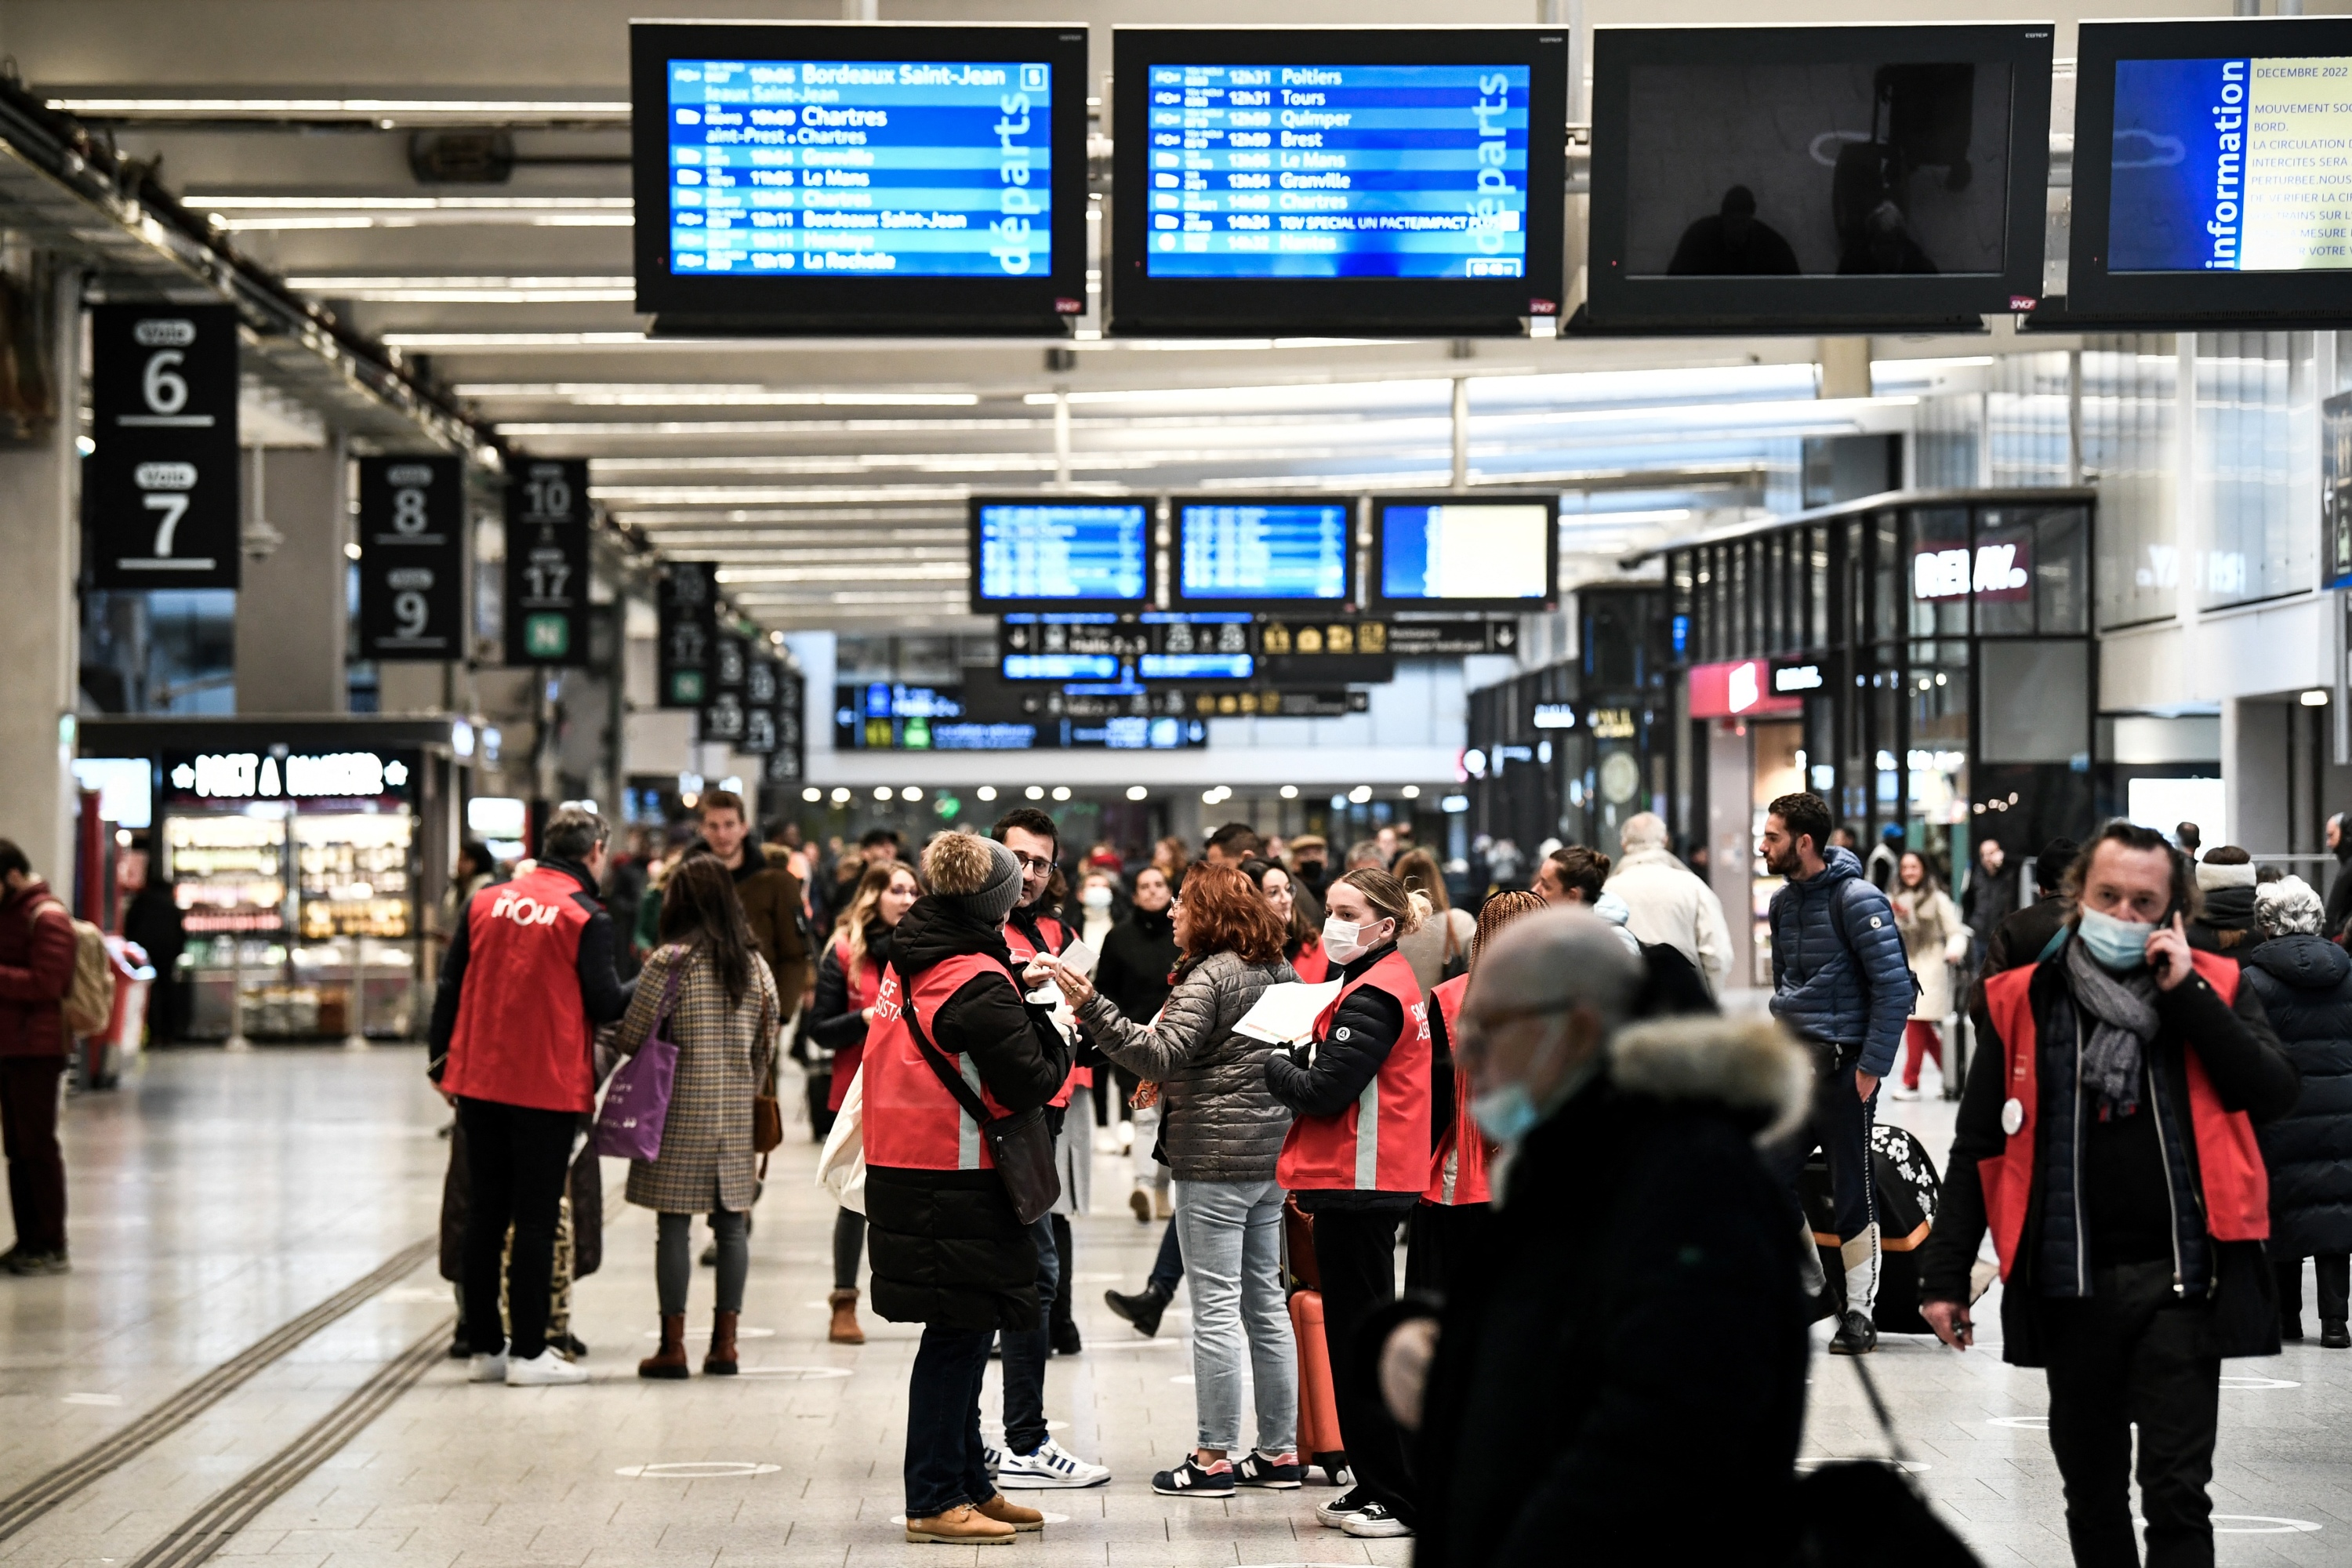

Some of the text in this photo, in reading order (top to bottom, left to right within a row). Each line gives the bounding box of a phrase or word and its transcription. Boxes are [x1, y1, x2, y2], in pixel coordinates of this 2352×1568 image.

[803, 64, 896, 85] Bordeaux
[899, 64, 1006, 85] Saint-Jean
[1281, 67, 1343, 85] Poitiers
[2256, 67, 2348, 78] DECEMBRE 2022
[1280, 89, 1326, 106] Tours
[802, 106, 887, 126] Chartres
[2255, 103, 2329, 114] MOUVEMENT
[1280, 109, 1352, 130] Quimper
[2254, 122, 2288, 132] BORD.
[797, 127, 867, 144] Chartres
[1280, 130, 1323, 147] Brest
[2252, 139, 2345, 150] LA CIRCULATION
[1280, 151, 1300, 169] Le
[1302, 151, 1347, 169] Mans
[1465, 72, 1516, 255] départs
[2205, 61, 2244, 269] information
[2252, 157, 2348, 168] INTERCITES SERA
[989, 93, 1041, 274] départs
[1279, 172, 1351, 190] Granville
[1279, 192, 1348, 210] Chartres
[2321, 193, 2336, 202] LA
[2319, 211, 2342, 220] SUR
[2300, 228, 2347, 238] MESURE
[2310, 245, 2346, 256] VOTRE
[2010, 299, 2036, 310] SNCF
[143, 350, 189, 415] 6
[523, 480, 572, 517] 10
[394, 488, 427, 535] 8
[143, 493, 190, 557] 7
[523, 562, 572, 601] 17
[394, 590, 430, 638] 9
